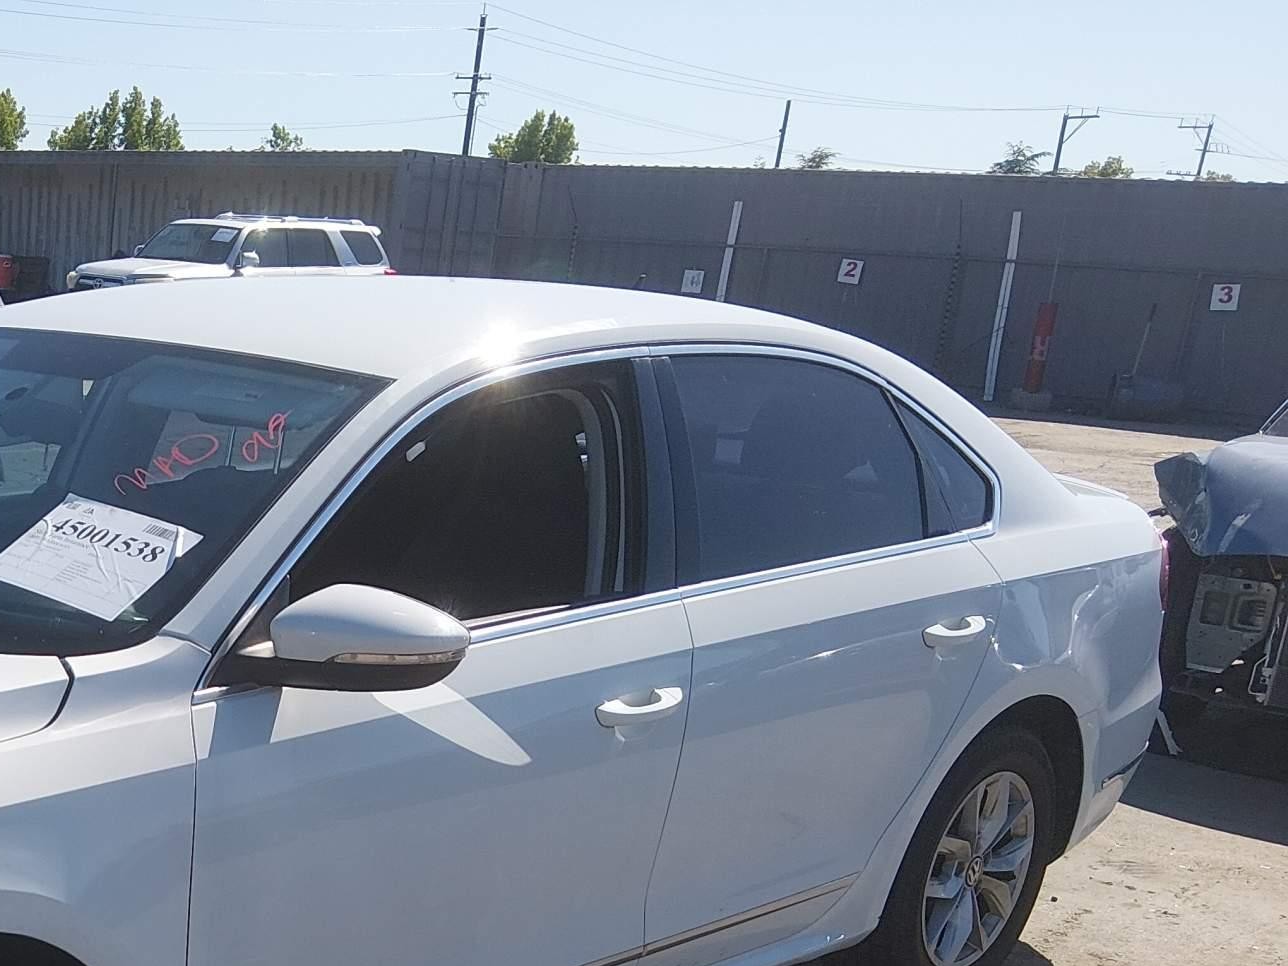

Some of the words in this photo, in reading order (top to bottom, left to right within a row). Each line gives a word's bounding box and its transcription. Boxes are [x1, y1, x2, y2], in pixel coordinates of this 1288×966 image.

[844, 261, 857, 277] 2
[1218, 285, 1233, 304] 3
[51, 518, 166, 563] 45001538
